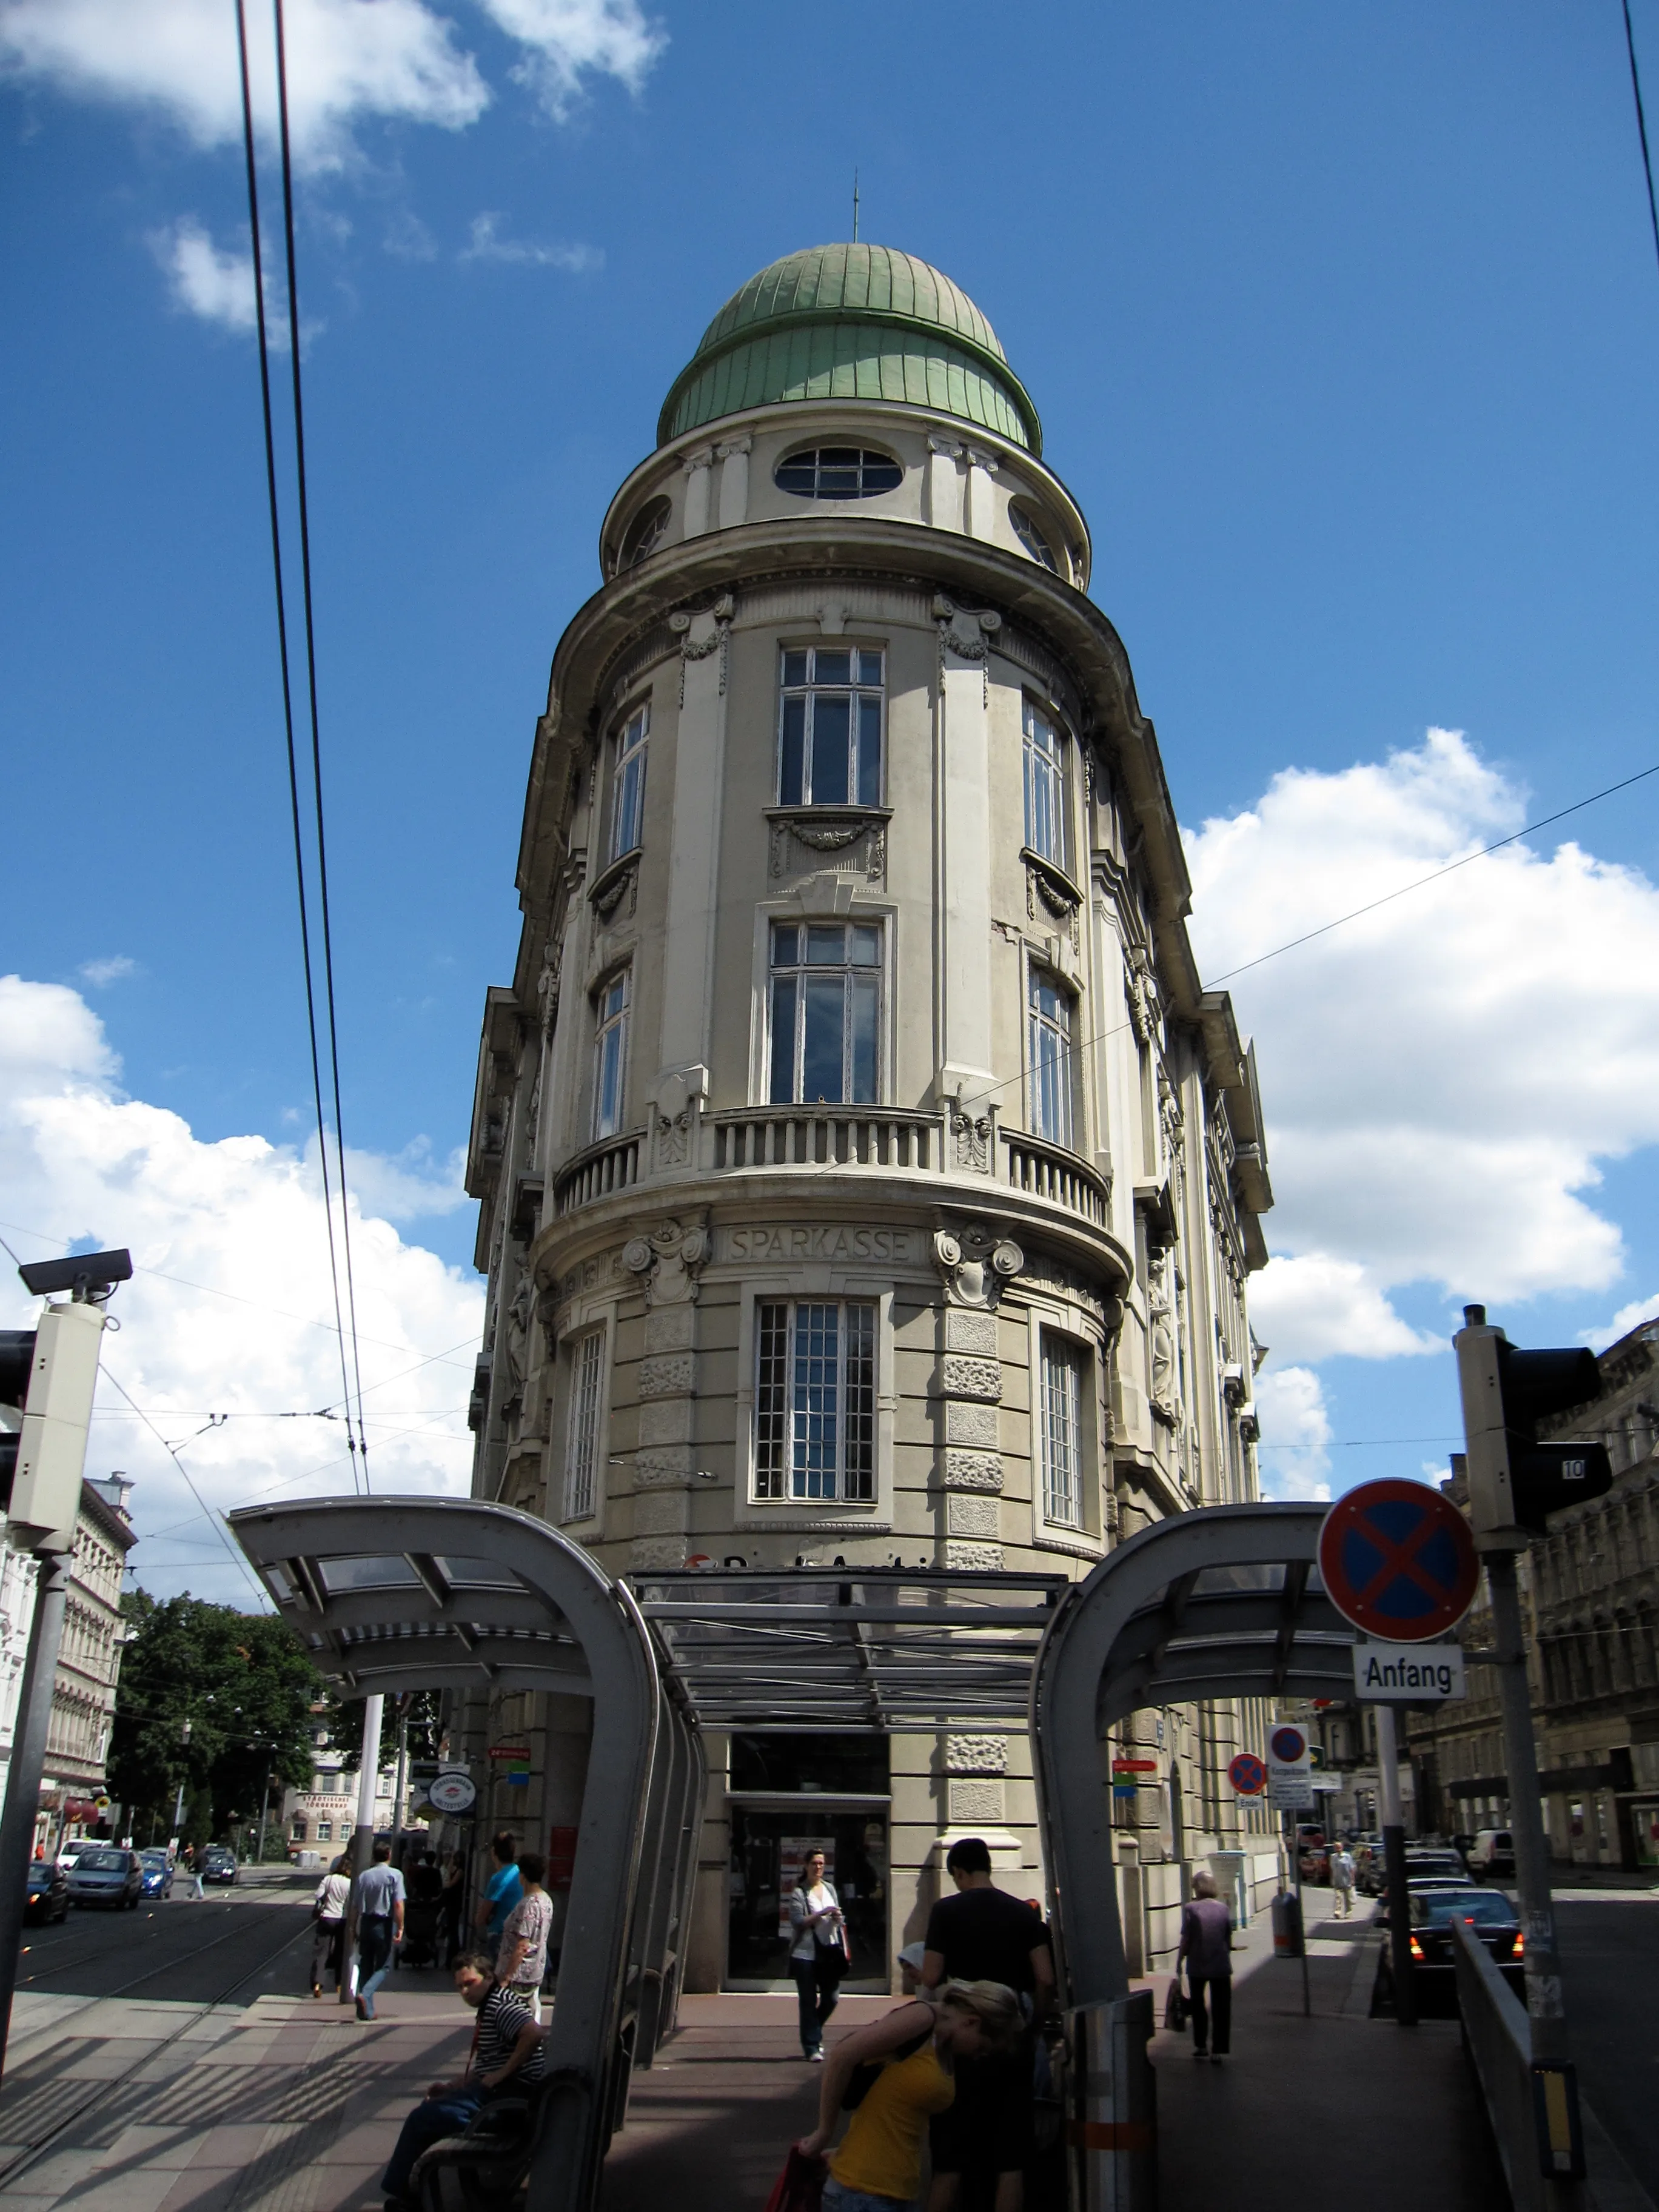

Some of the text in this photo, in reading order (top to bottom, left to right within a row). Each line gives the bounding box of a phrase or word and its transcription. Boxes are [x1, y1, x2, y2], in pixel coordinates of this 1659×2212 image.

[730, 1228, 910, 1261] SPARKASSE
[1565, 1461, 1583, 1477] 10
[1366, 1657, 1452, 1695] Anfang
[435, 1797, 469, 1809] HALTESTELLE
[1240, 1798, 1259, 1807] Ende
